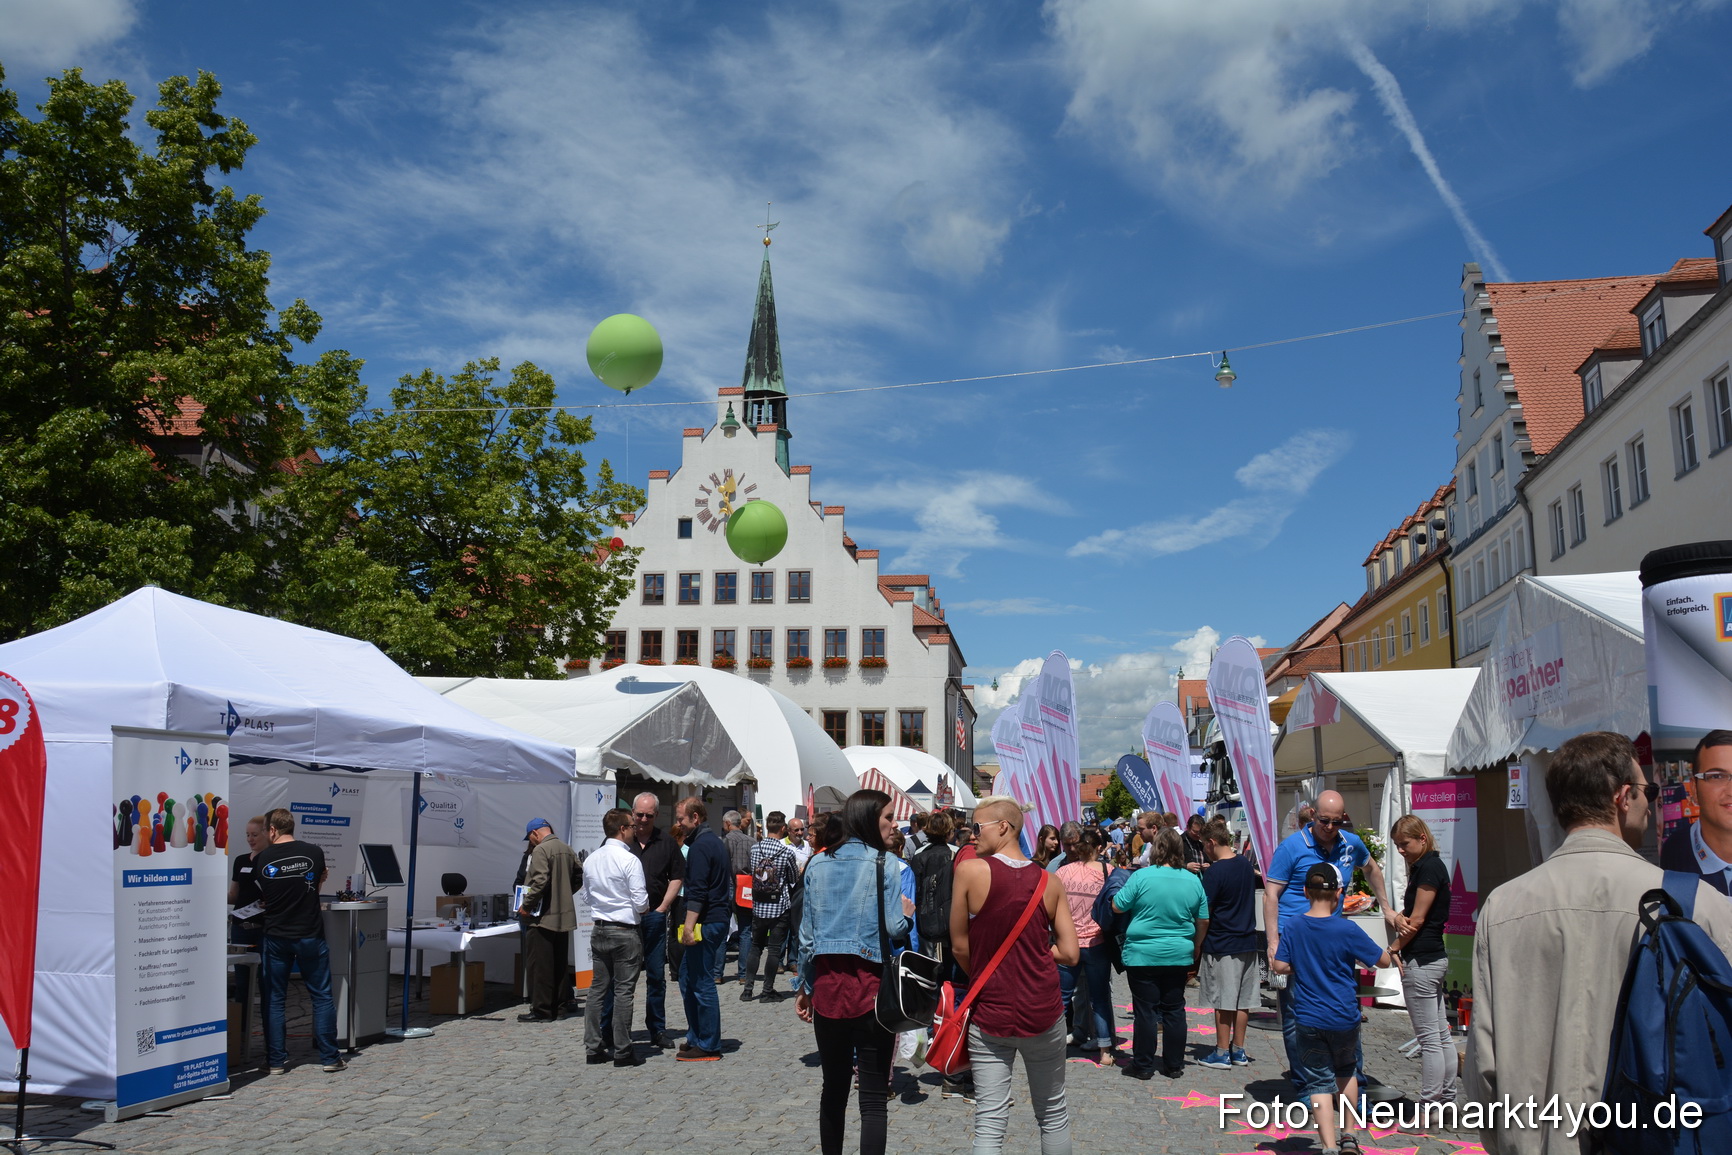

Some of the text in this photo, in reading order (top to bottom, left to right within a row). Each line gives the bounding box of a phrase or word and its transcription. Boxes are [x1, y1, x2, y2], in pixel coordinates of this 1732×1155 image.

[1666, 595, 1694, 606] Einfach.
[1667, 603, 1709, 616] Erfolgreich.
[1506, 657, 1564, 706] partner
[219, 712, 275, 732] TR PLAST
[174, 755, 220, 767] TR PLAST
[1415, 790, 1473, 803] Wir stellen ein.
[1510, 789, 1521, 803] 36
[292, 804, 328, 812] Unterstützen
[430, 801, 457, 810] Qualität
[280, 861, 308, 872] Qualität
[127, 871, 187, 884] Wir bilden aus!
[138, 898, 191, 907] Verfahrensmechaniker
[146, 906, 173, 914] Kunststoff-
[173, 905, 183, 913] und
[138, 913, 181, 922] Kautschuktechnik
[138, 920, 191, 931] Ausrichtung Formteile
[138, 932, 208, 944] Maschinen- und Anlagenführer
[138, 946, 199, 958] Fachkraft für Lagerlogistik
[138, 960, 178, 971] Kauffrau/-mann
[138, 967, 189, 979] für Büromanagement
[139, 980, 196, 993] Industriekauffrau/-mann
[139, 993, 186, 1007] Fachinformatiker/in
[162, 1024, 217, 1040] www.tr-plast.de/karriere
[183, 1058, 219, 1072] TR PLAST GmbH
[173, 1081, 187, 1090] 92318
